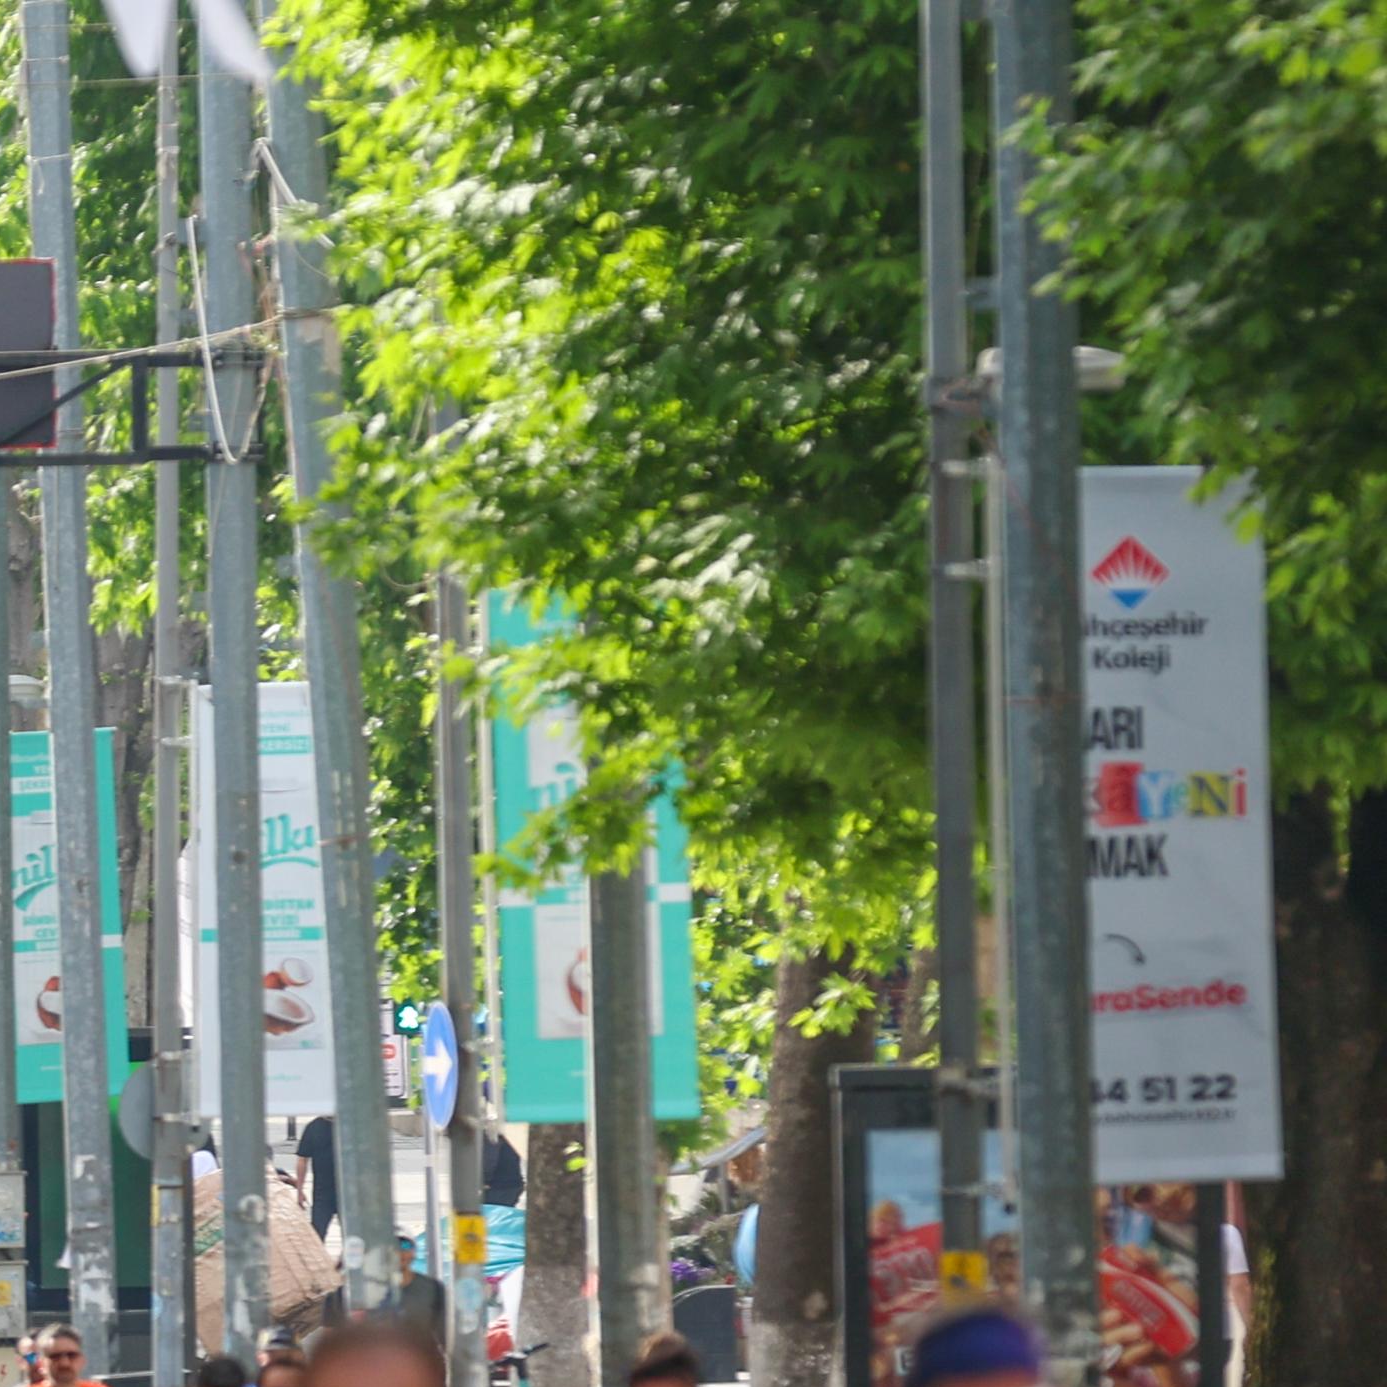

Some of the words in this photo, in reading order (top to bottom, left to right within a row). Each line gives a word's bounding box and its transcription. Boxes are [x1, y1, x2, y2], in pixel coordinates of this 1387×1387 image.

[1093, 643, 1172, 676] Koleji
[1141, 1075, 1176, 1103] 51
[1189, 1073, 1237, 1101] 22
